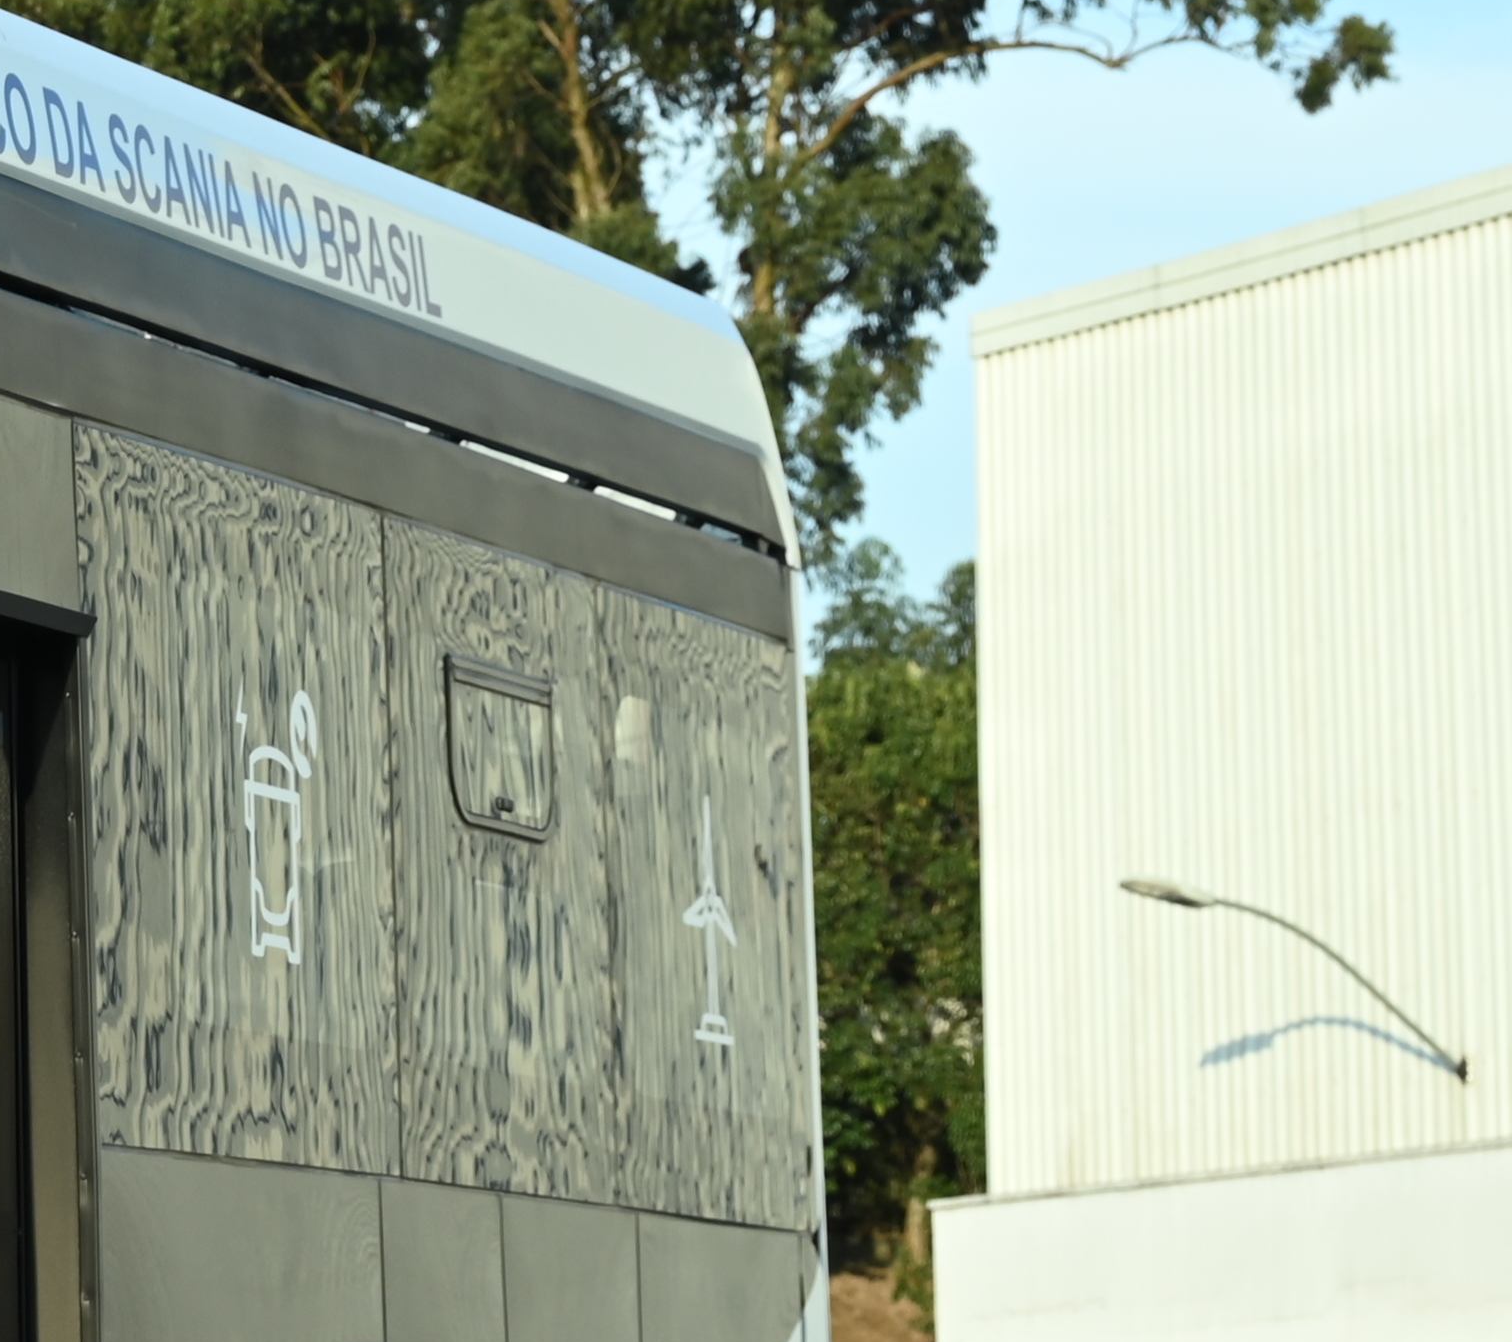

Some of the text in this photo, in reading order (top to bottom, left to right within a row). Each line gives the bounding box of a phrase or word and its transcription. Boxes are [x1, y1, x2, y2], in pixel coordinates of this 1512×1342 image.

[42, 86, 106, 193] DA
[108, 113, 252, 249] SCANIA
[252, 171, 307, 269] NO
[313, 195, 442, 318] BRASIL
